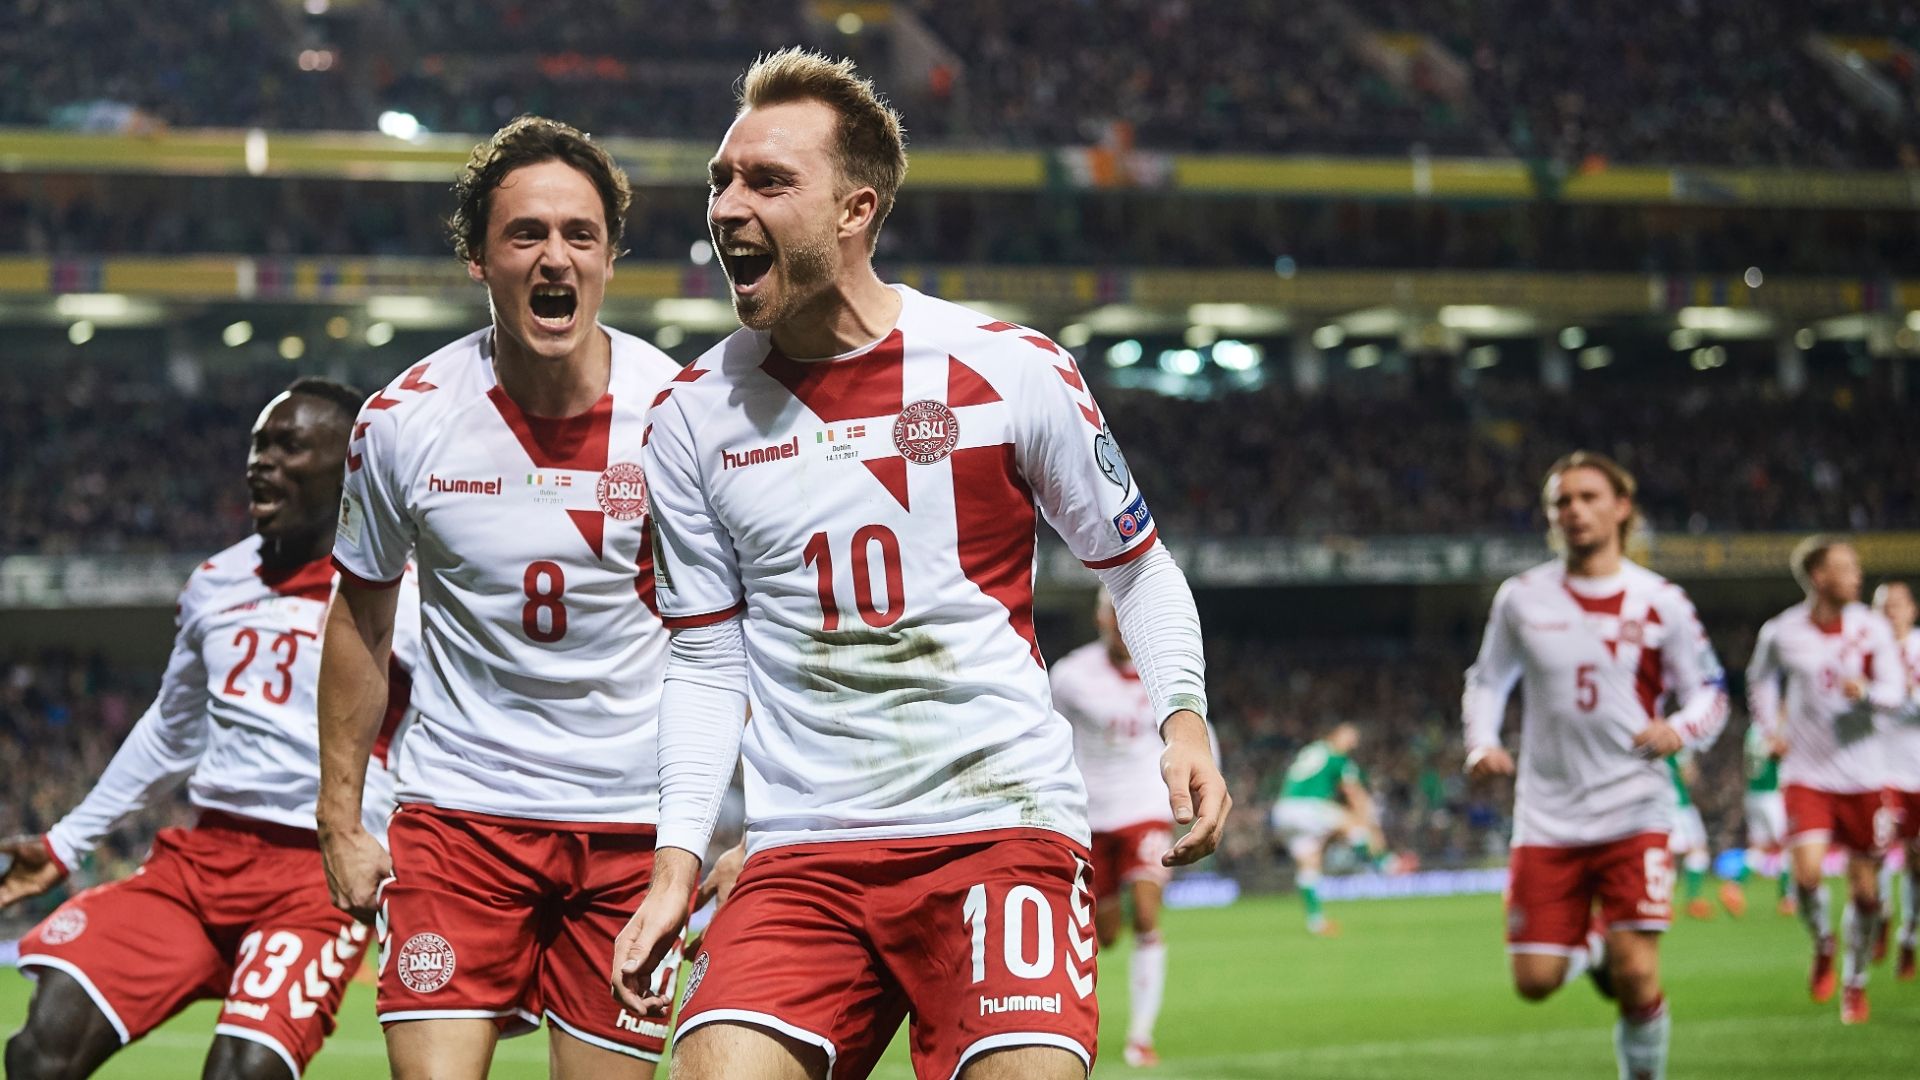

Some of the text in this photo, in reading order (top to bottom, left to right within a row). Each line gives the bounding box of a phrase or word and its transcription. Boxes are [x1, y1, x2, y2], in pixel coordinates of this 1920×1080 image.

[906, 420, 946, 441] DBU
[722, 435, 799, 470] hummel
[833, 444, 852, 452] Dublin
[915, 451, 941, 462] 1889
[428, 473, 502, 495] hummel
[608, 481, 643, 500] DBU
[802, 524, 906, 631] 10
[522, 560, 568, 644] 8
[223, 626, 299, 706] 23
[1577, 664, 1599, 713] 5
[962, 883, 1055, 985] 10
[409, 951, 443, 971] DBU
[980, 993, 1061, 1016] hummel
